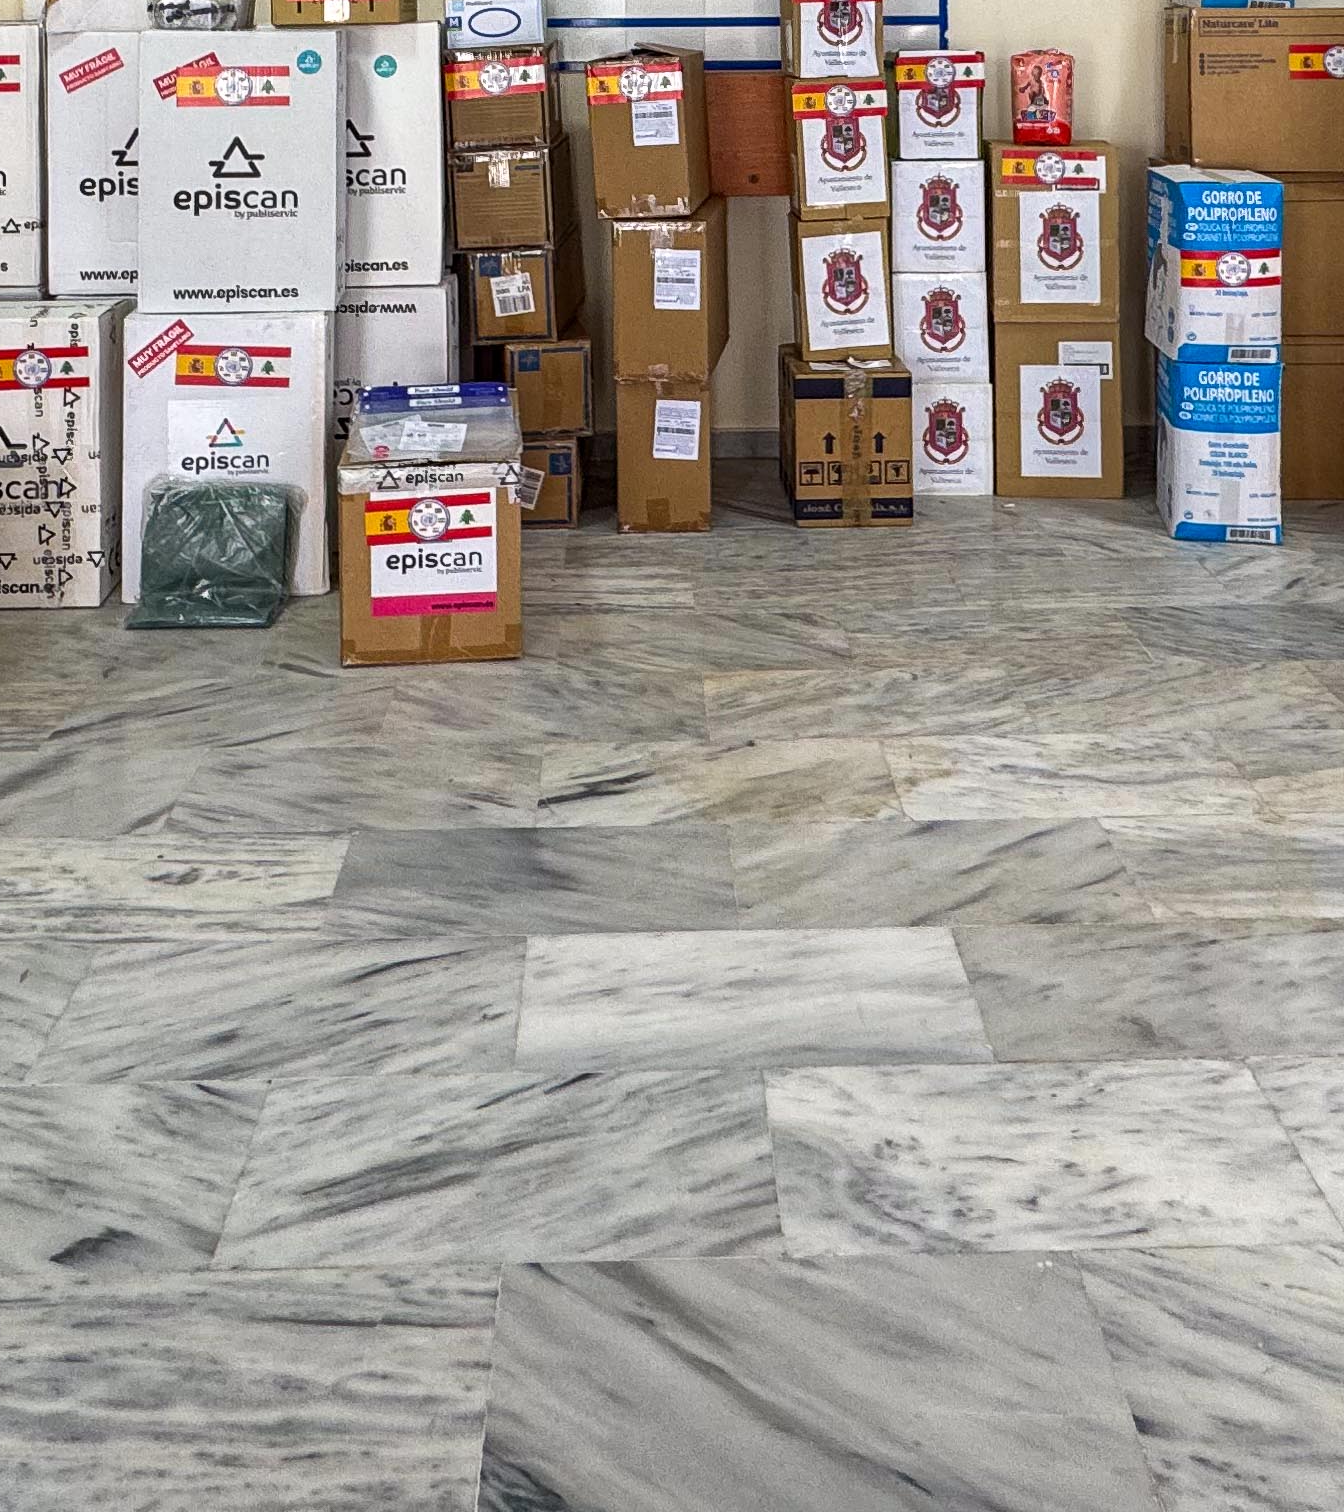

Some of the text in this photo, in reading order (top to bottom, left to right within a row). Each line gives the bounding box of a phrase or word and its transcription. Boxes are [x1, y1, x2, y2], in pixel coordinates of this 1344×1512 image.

[63, 51, 117, 83] MUY FRÁGIL
[346, 167, 407, 186] scan
[79, 171, 138, 202] epis
[173, 183, 298, 216] episcan
[1202, 190, 1262, 205] GORRO DE
[246, 208, 298, 220] publiservic
[1187, 207, 1278, 223] POLIPROPILENO
[173, 285, 299, 303] www.episcan.es
[132, 324, 185, 370] MUY FRÁGIL
[1199, 370, 1260, 387] GORRO DE
[33, 387, 44, 418] scan
[1183, 387, 1275, 404] POLIPROPILENO
[181, 451, 270, 475] episcan
[405, 469, 465, 486] episcan
[386, 547, 483, 575] episcan
